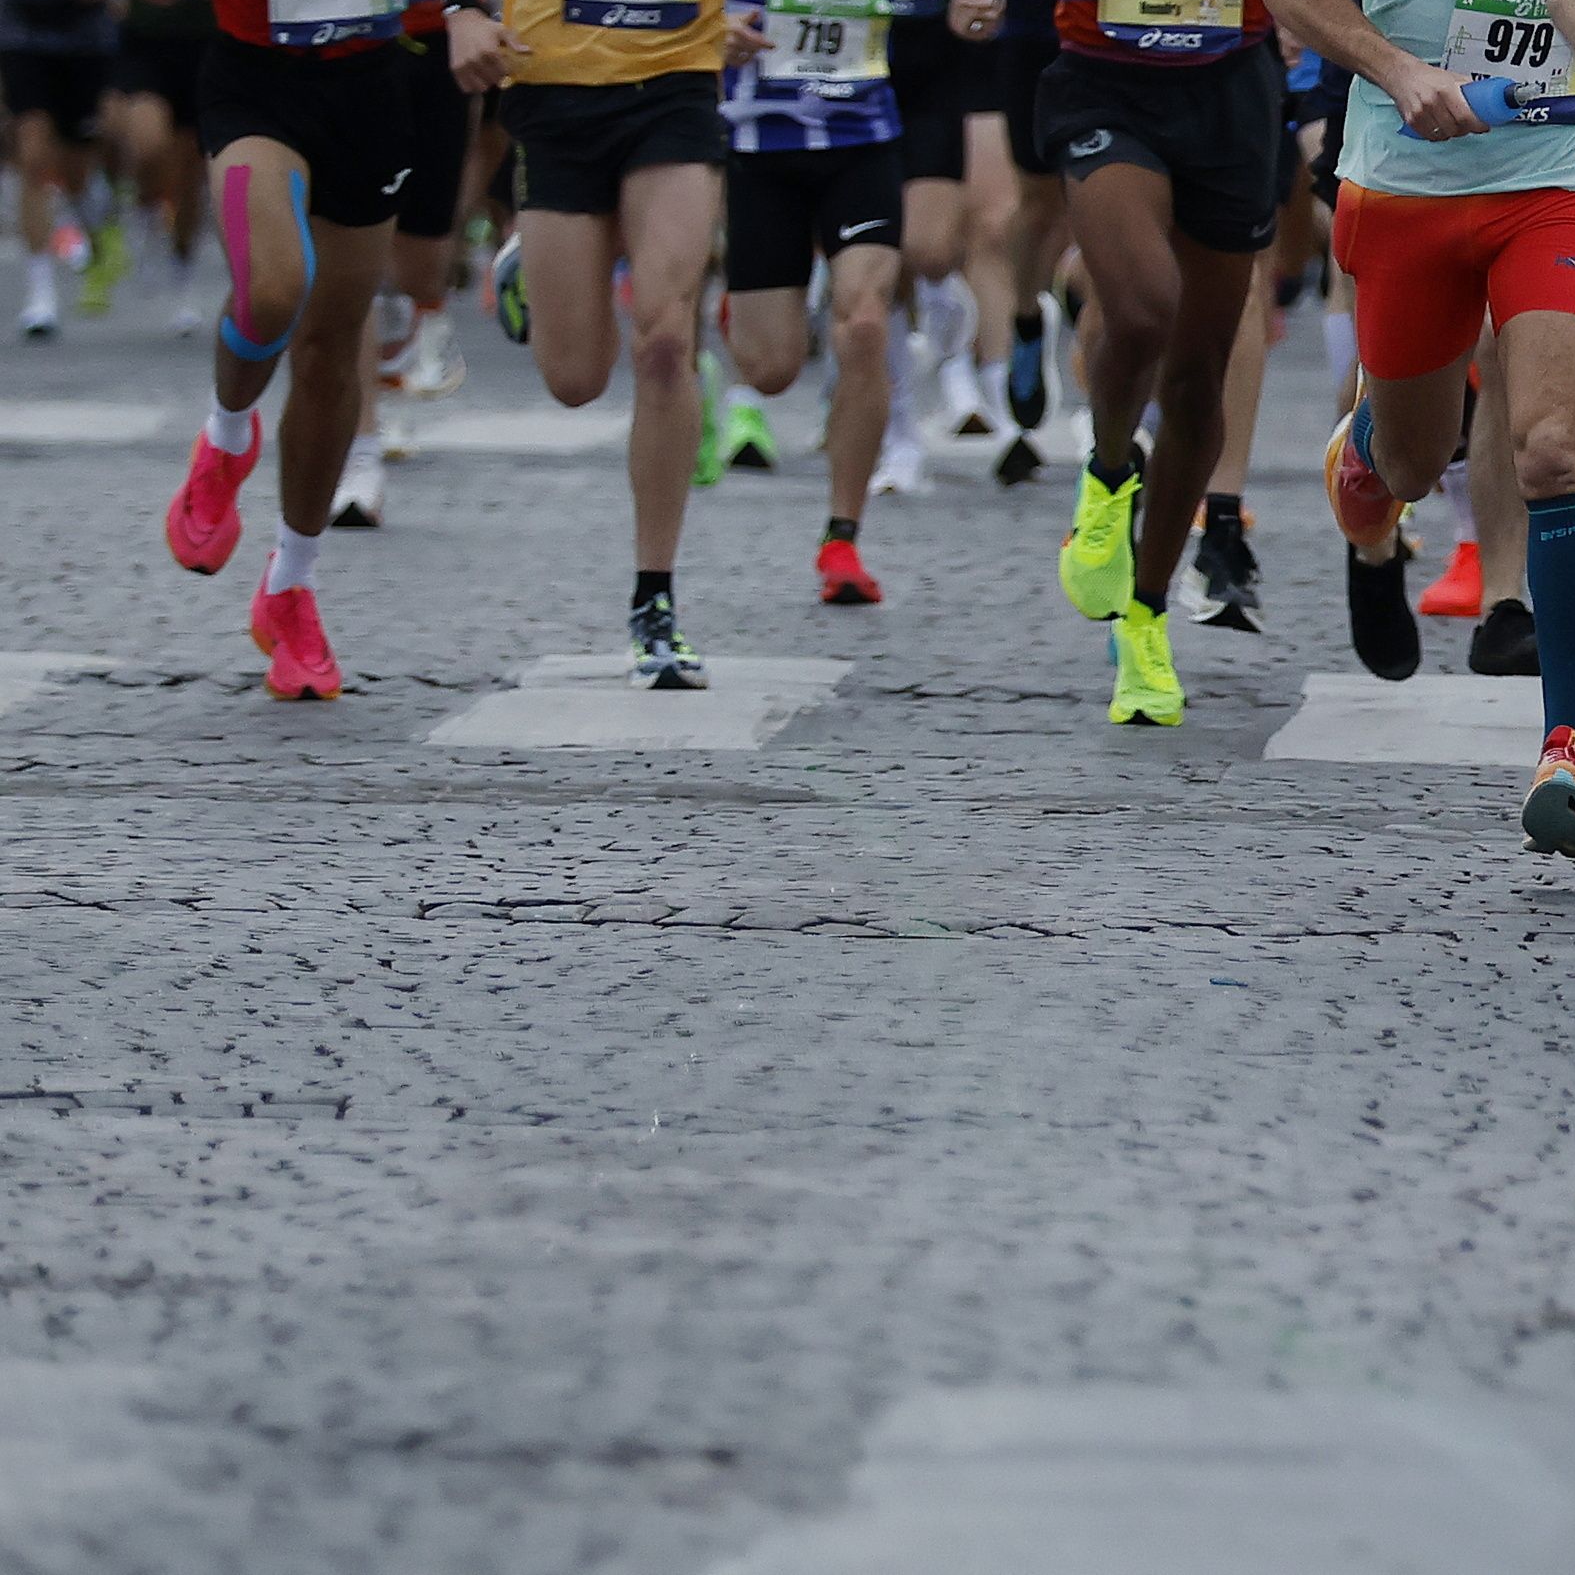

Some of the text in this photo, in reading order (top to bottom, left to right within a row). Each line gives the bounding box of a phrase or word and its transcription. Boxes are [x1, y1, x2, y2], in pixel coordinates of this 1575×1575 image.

[797, 20, 842, 55] 719
[1484, 19, 1554, 68] 979
[1517, 106, 1551, 123] sics
